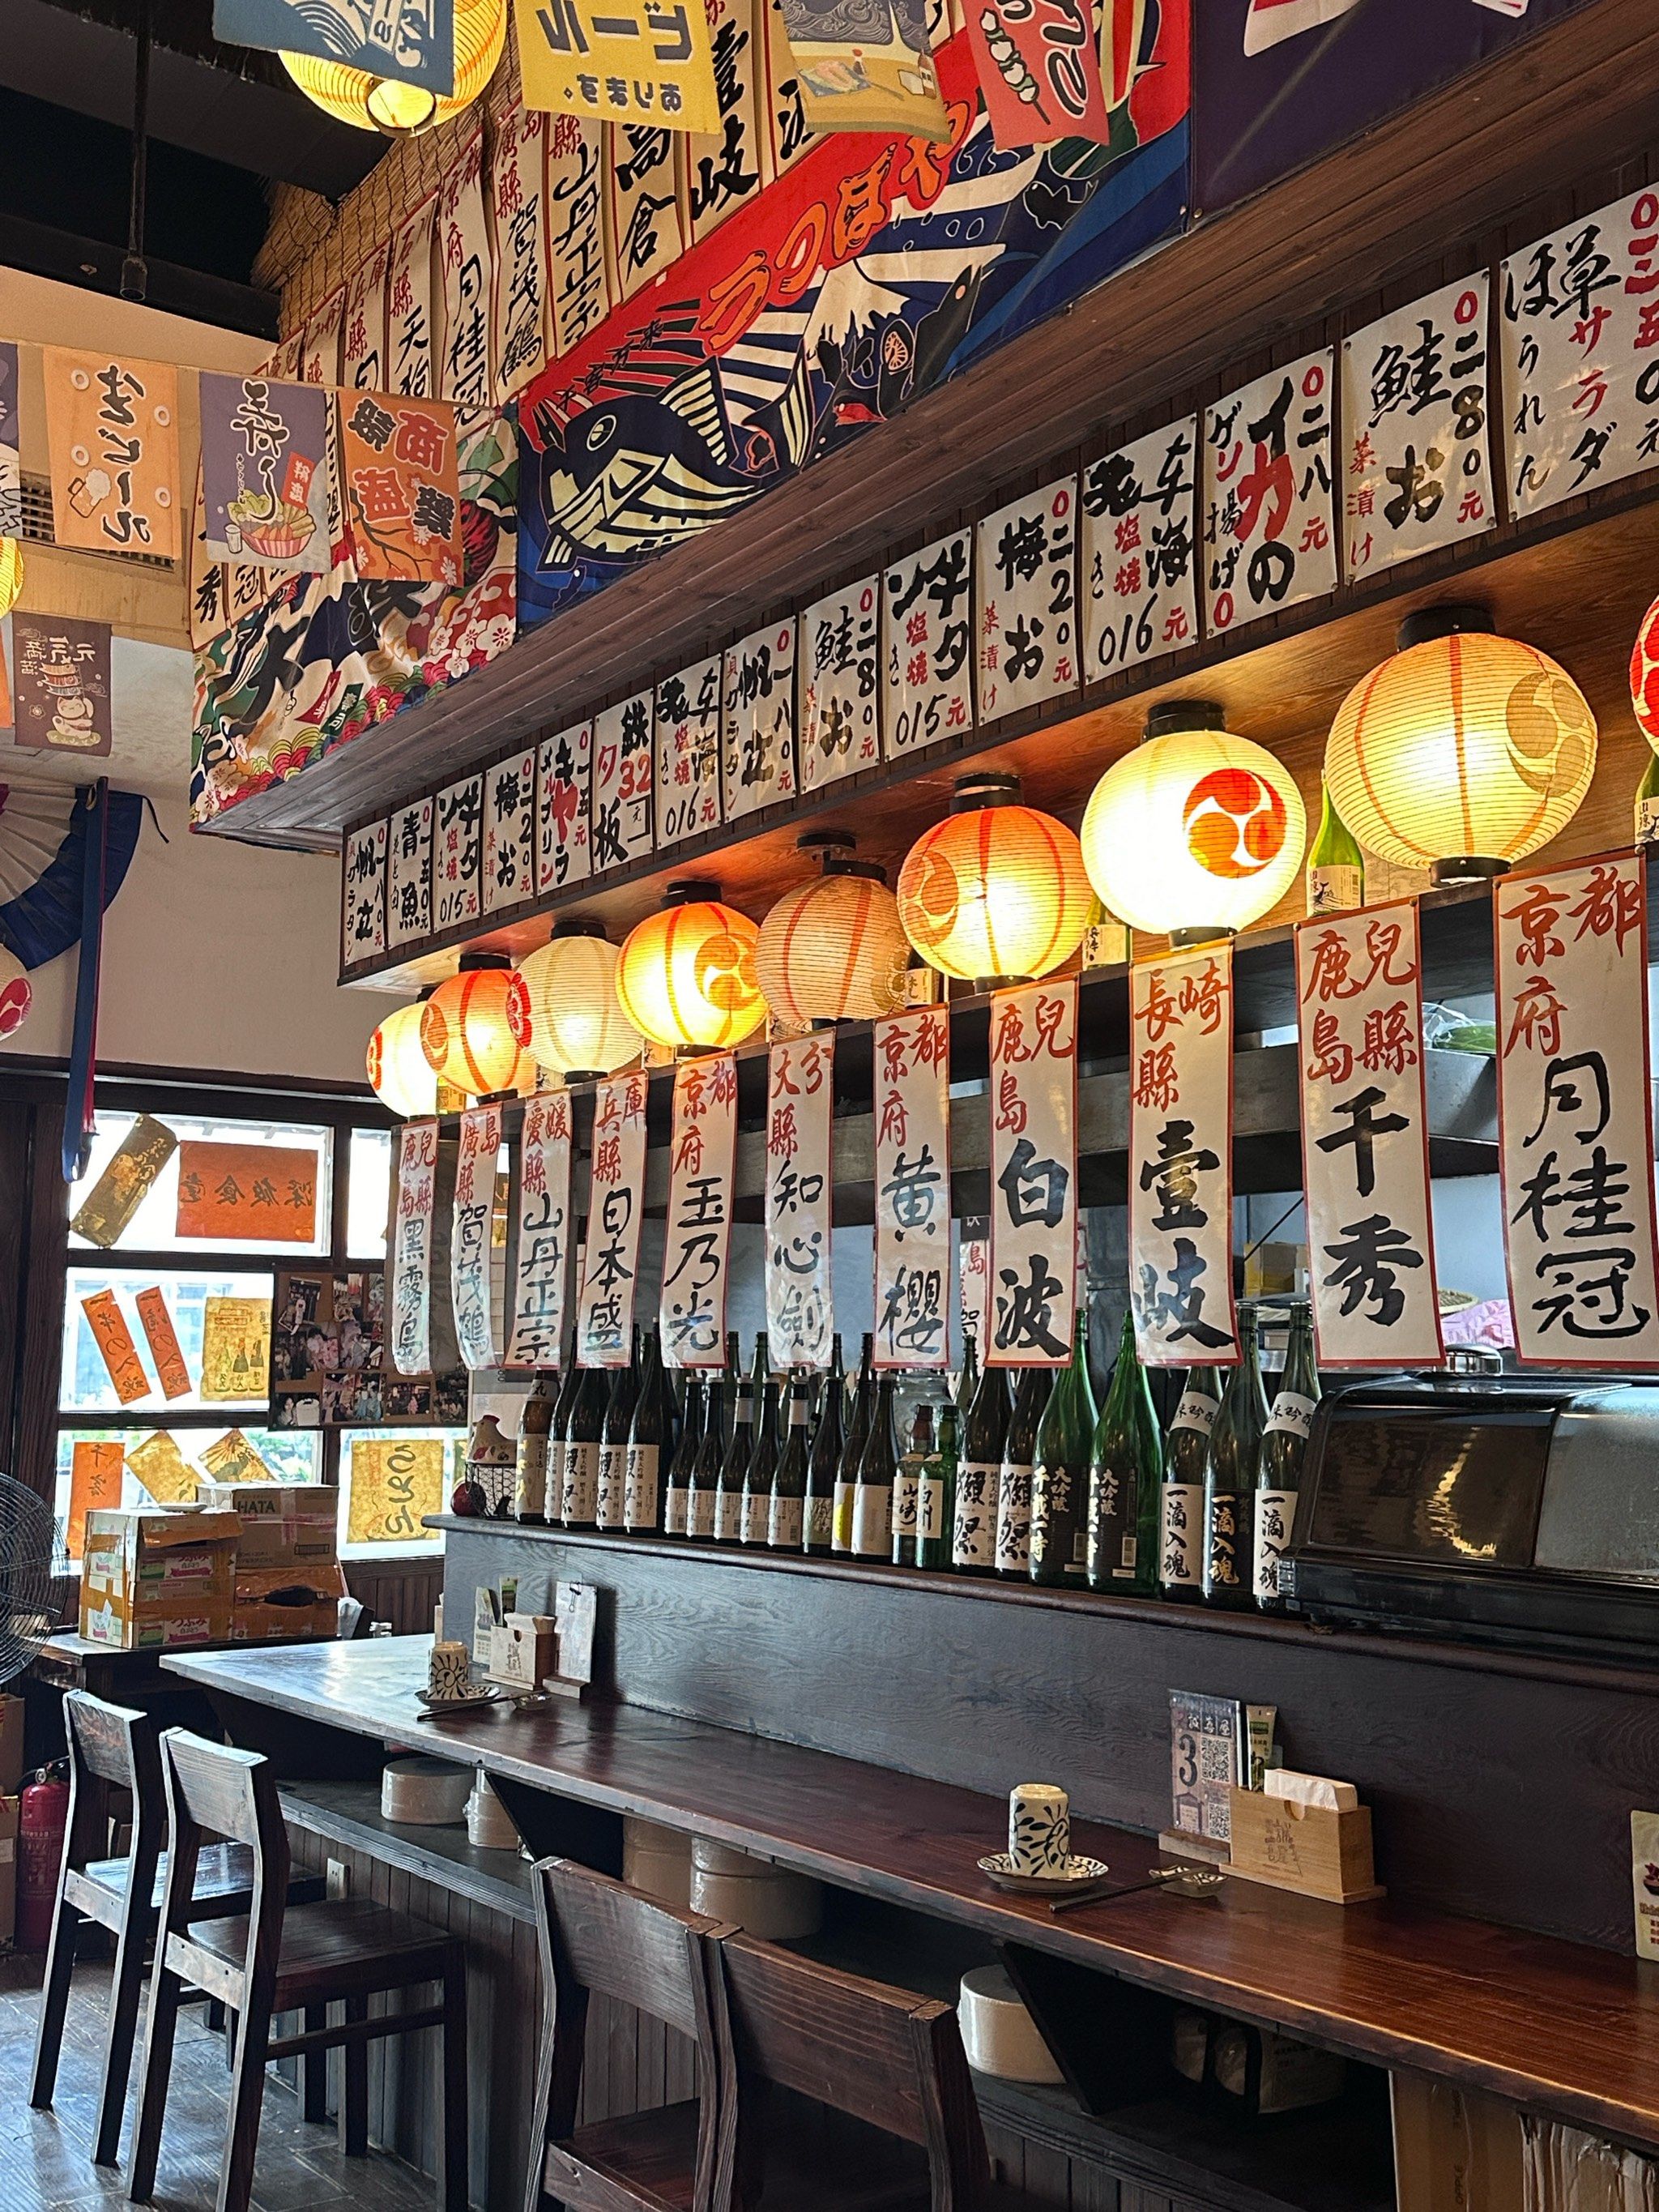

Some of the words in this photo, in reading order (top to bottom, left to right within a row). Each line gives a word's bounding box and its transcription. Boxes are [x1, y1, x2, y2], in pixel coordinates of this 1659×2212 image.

[514, 1193, 564, 1364] 山丹正宗
[585, 1187, 634, 1352] 日本盛
[663, 1176, 725, 1352] 玉乃光
[996, 1138, 1073, 1360] 白波
[1512, 1051, 1652, 1341] 月桂冠
[1179, 1733, 1198, 1787] 3
